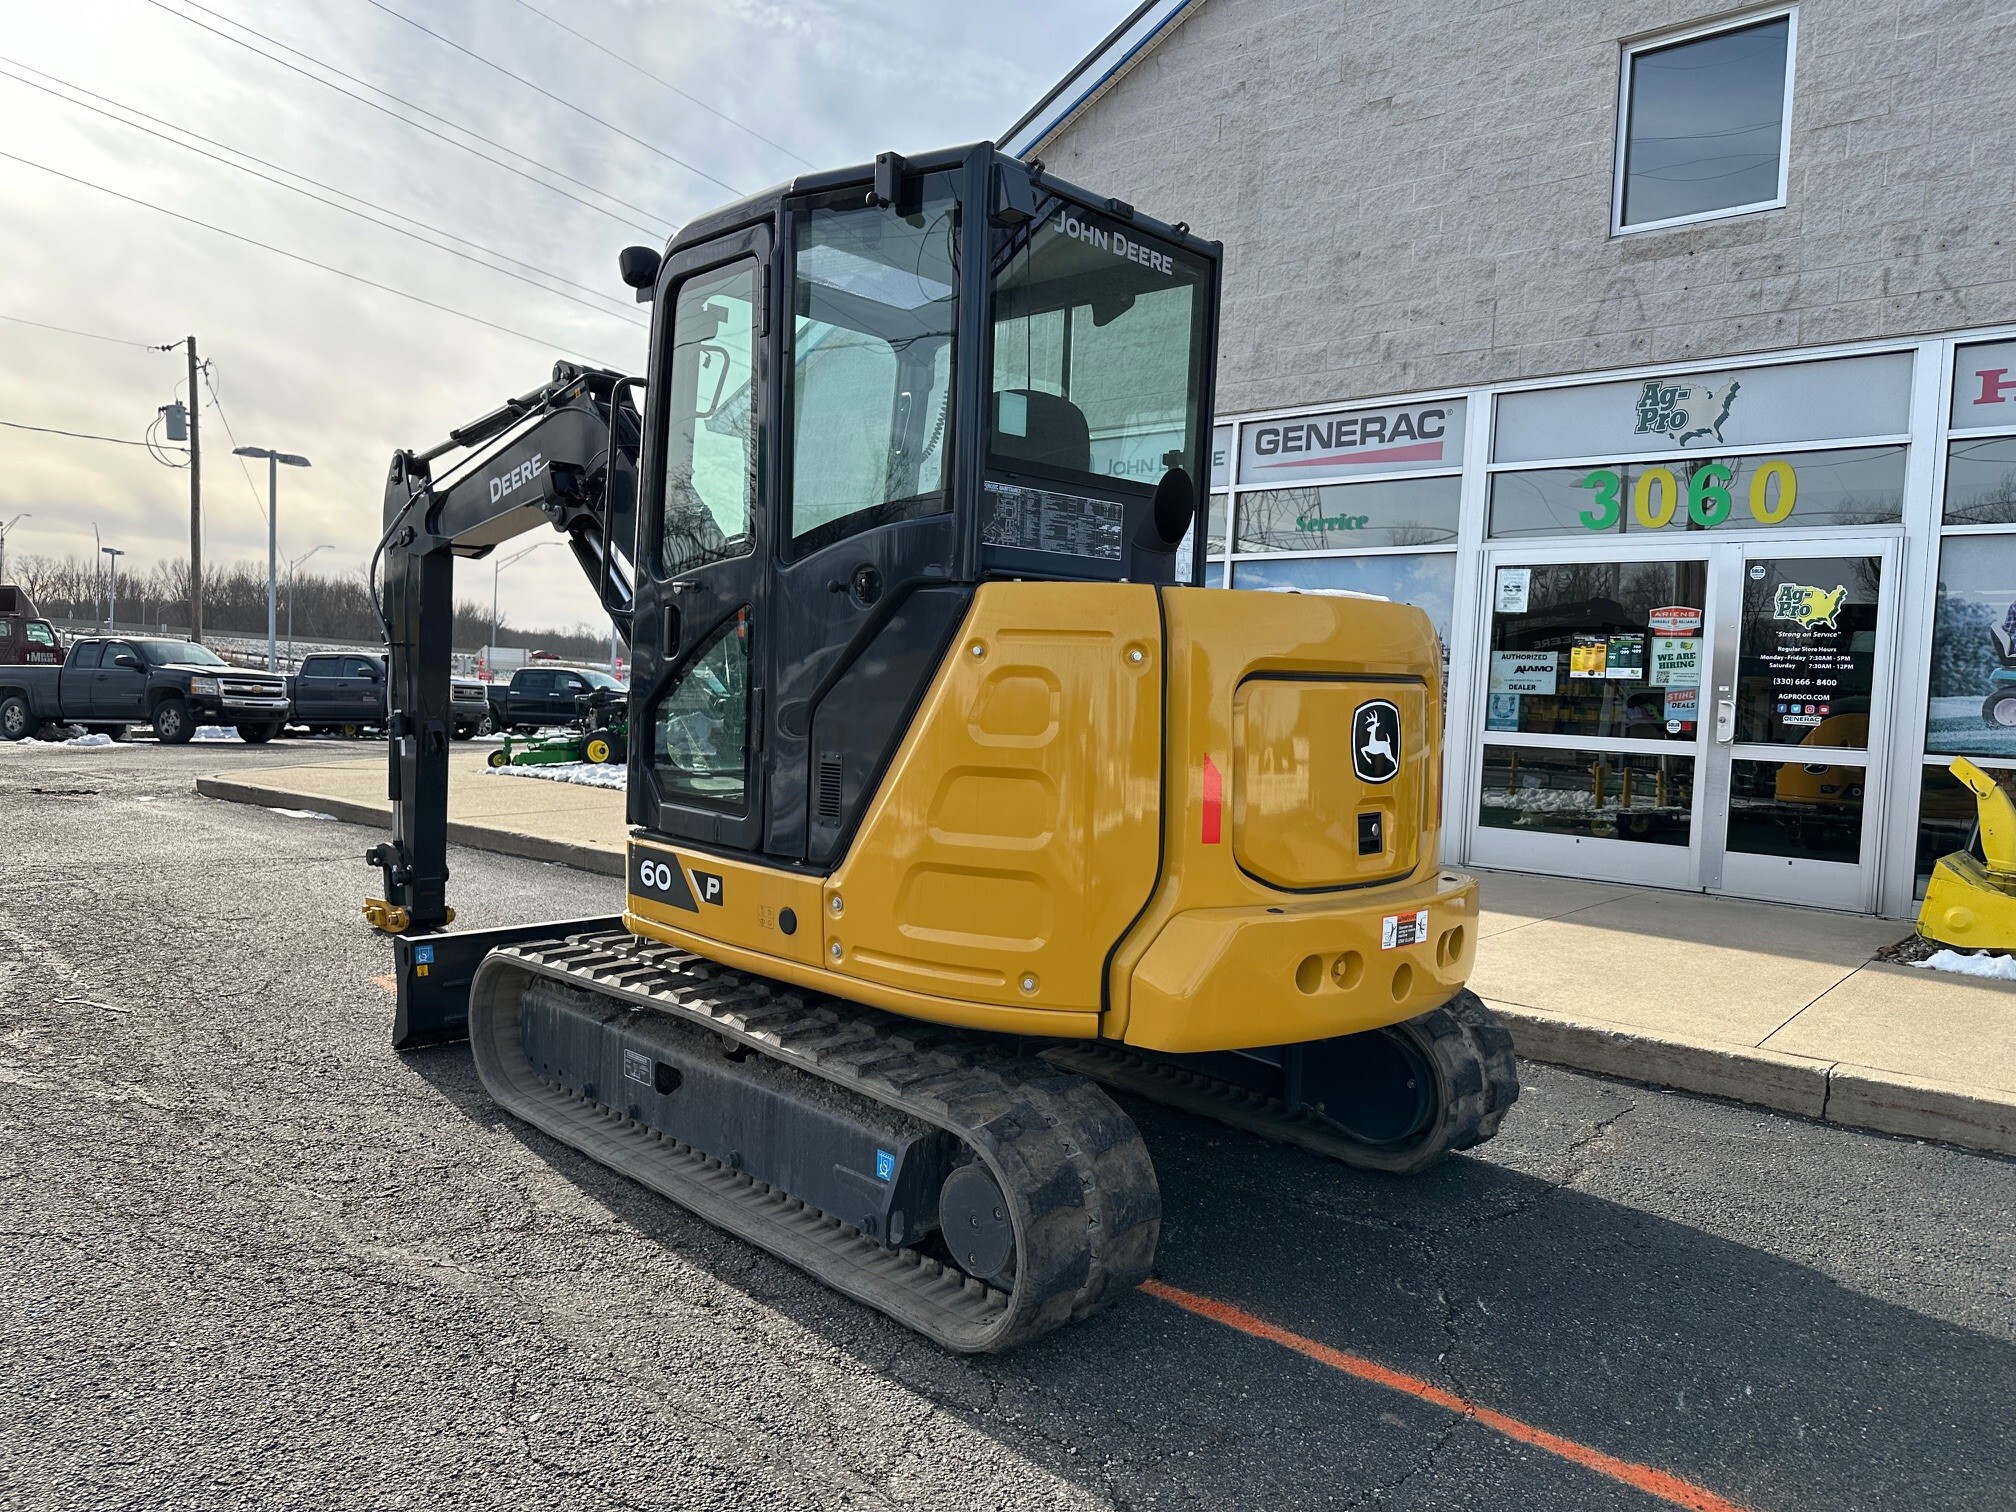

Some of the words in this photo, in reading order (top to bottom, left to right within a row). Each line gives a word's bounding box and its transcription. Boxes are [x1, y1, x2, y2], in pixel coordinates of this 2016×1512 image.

[1054, 210, 1108, 251] JOHN
[1112, 231, 1173, 275] DEERE
[1637, 381, 1691, 411] Ag-
[1634, 407, 1690, 434] Pro
[1255, 409, 1445, 456] GENERAC
[1106, 458, 1154, 476] JOHN
[490, 453, 542, 504] DEERE
[1579, 460, 1798, 531] 3060
[1296, 512, 1370, 532] Service
[1779, 585, 1813, 604] Ag-
[1776, 601, 1812, 617] Pro
[1657, 653, 1674, 661] WE
[1676, 652, 1696, 660] ARE
[1659, 660, 1695, 669] HIRING
[1514, 665, 1554, 674] ALAMO
[1773, 677, 1794, 686] (330)
[1668, 691, 1695, 701] STIHL
[1778, 693, 1830, 701] AGPROCO.COM
[1783, 715, 1821, 723] GENERAC
[640, 859, 672, 891] 60
[705, 876, 720, 900] P
